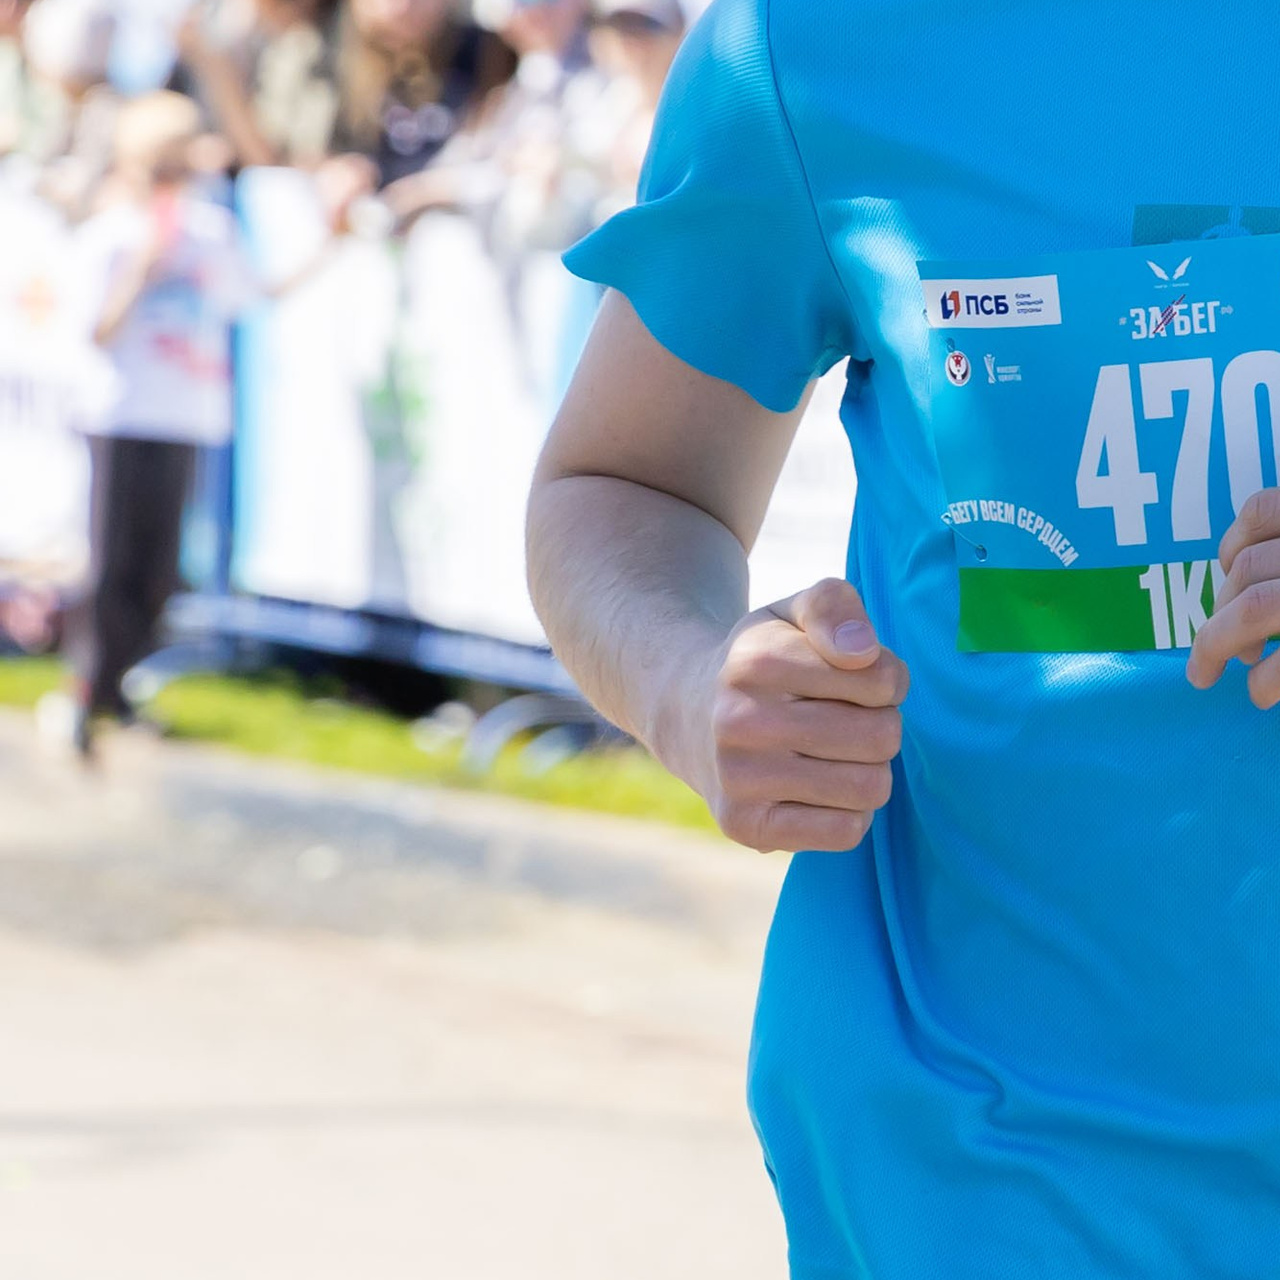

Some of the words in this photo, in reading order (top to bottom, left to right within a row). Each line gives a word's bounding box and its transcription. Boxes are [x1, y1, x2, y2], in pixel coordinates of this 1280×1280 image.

[965, 294, 1010, 316] ПСБ
[979, 499, 1015, 525] ВСЕМ
[1017, 506, 1080, 568] СЕРДЦЕМ
